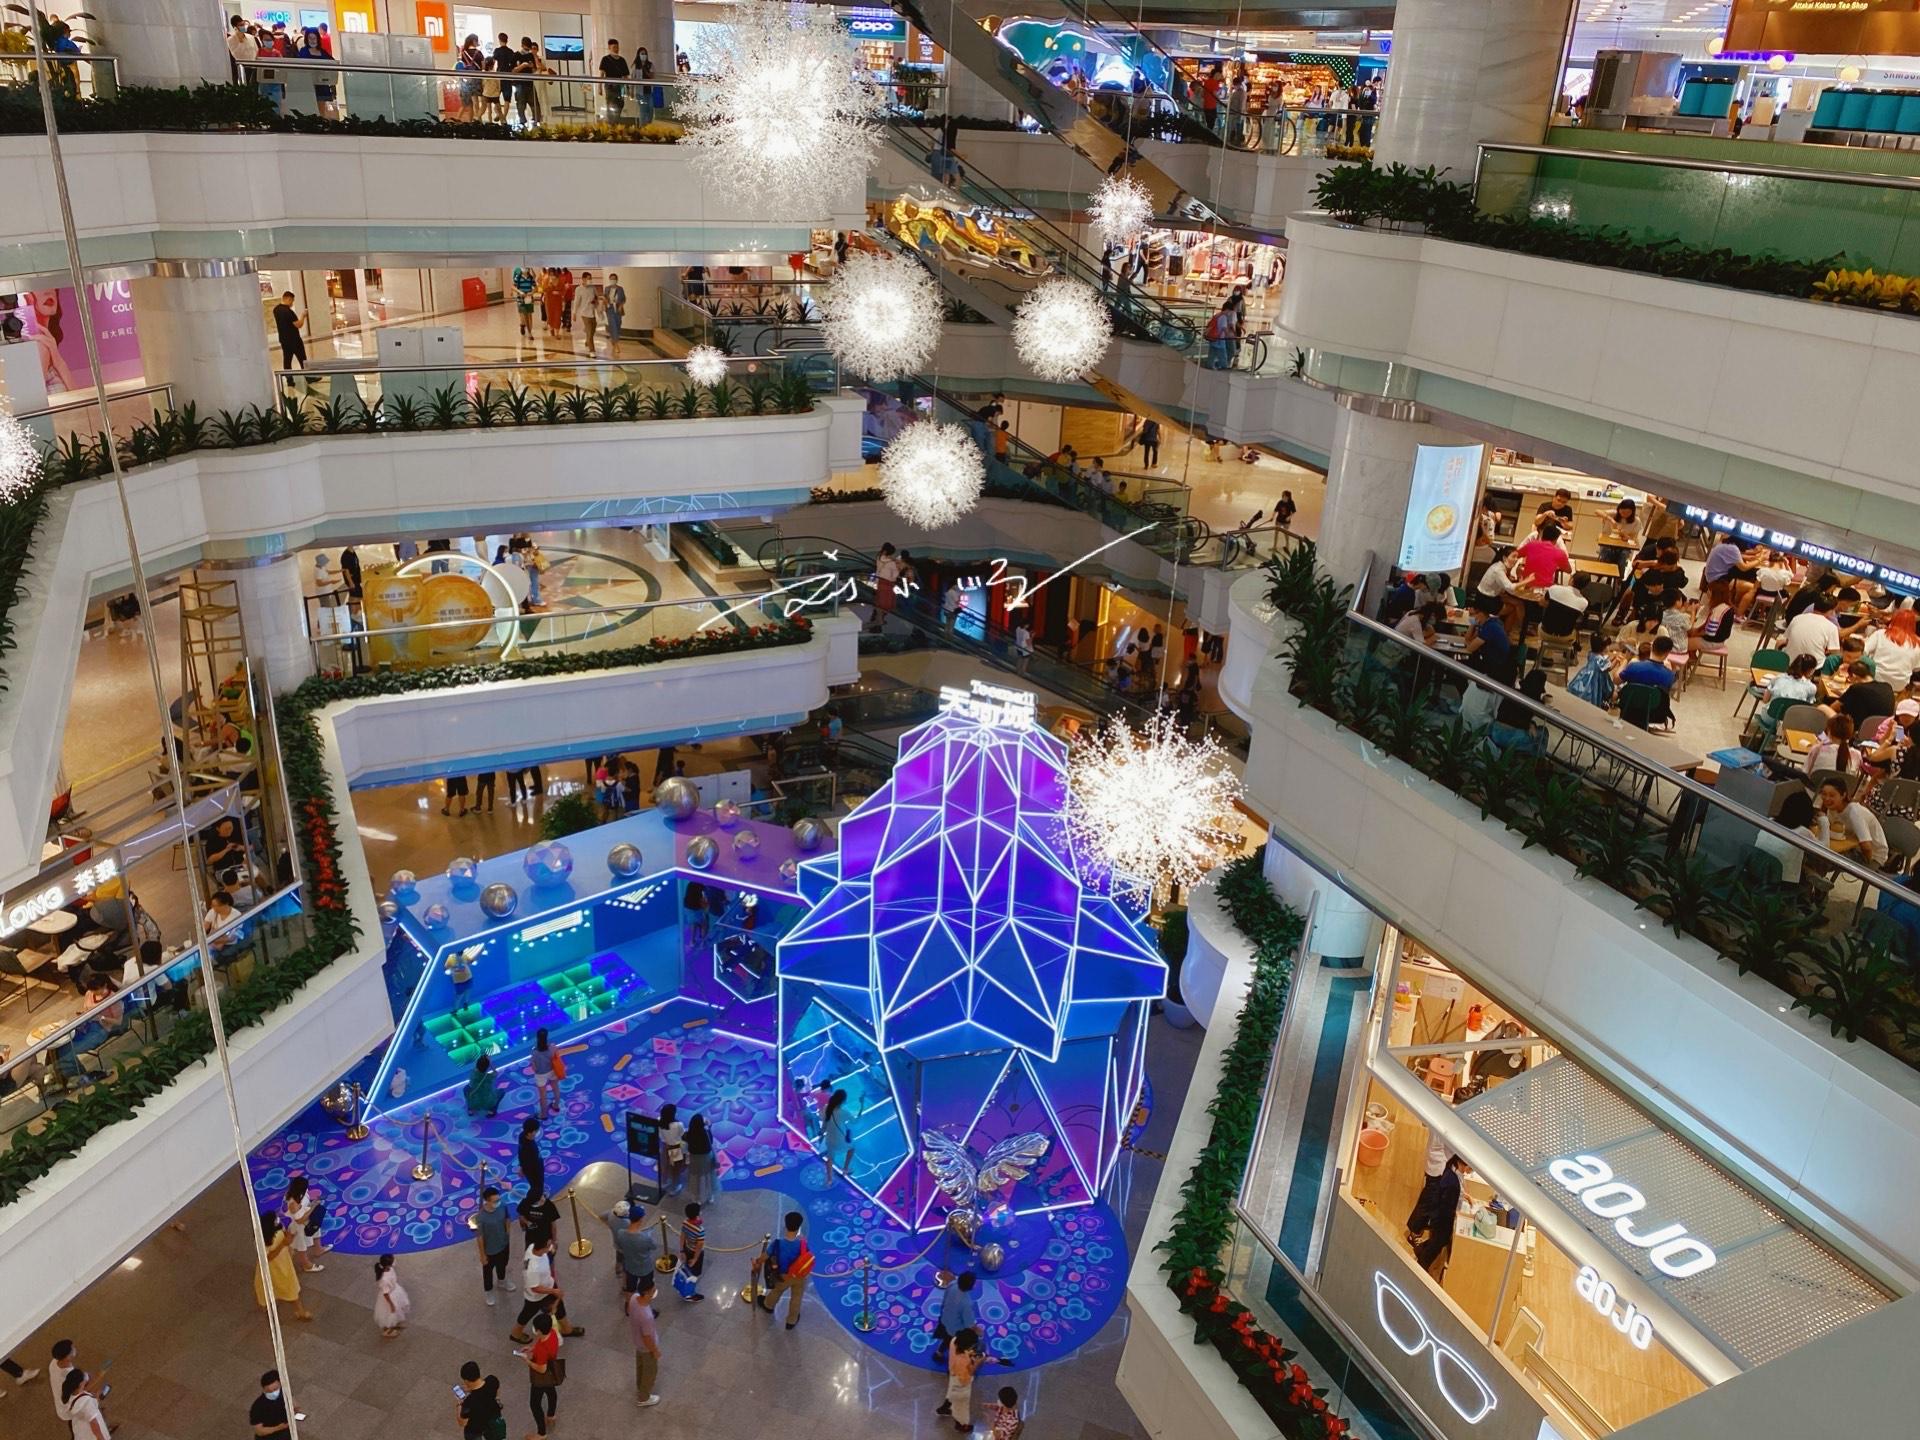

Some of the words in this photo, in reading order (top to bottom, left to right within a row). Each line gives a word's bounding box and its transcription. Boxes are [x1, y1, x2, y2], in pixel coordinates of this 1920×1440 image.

[256, 10, 292, 22] HONOR
[1800, 542, 1874, 574] HONEYMOON
[1880, 569, 1920, 589] DESSE
